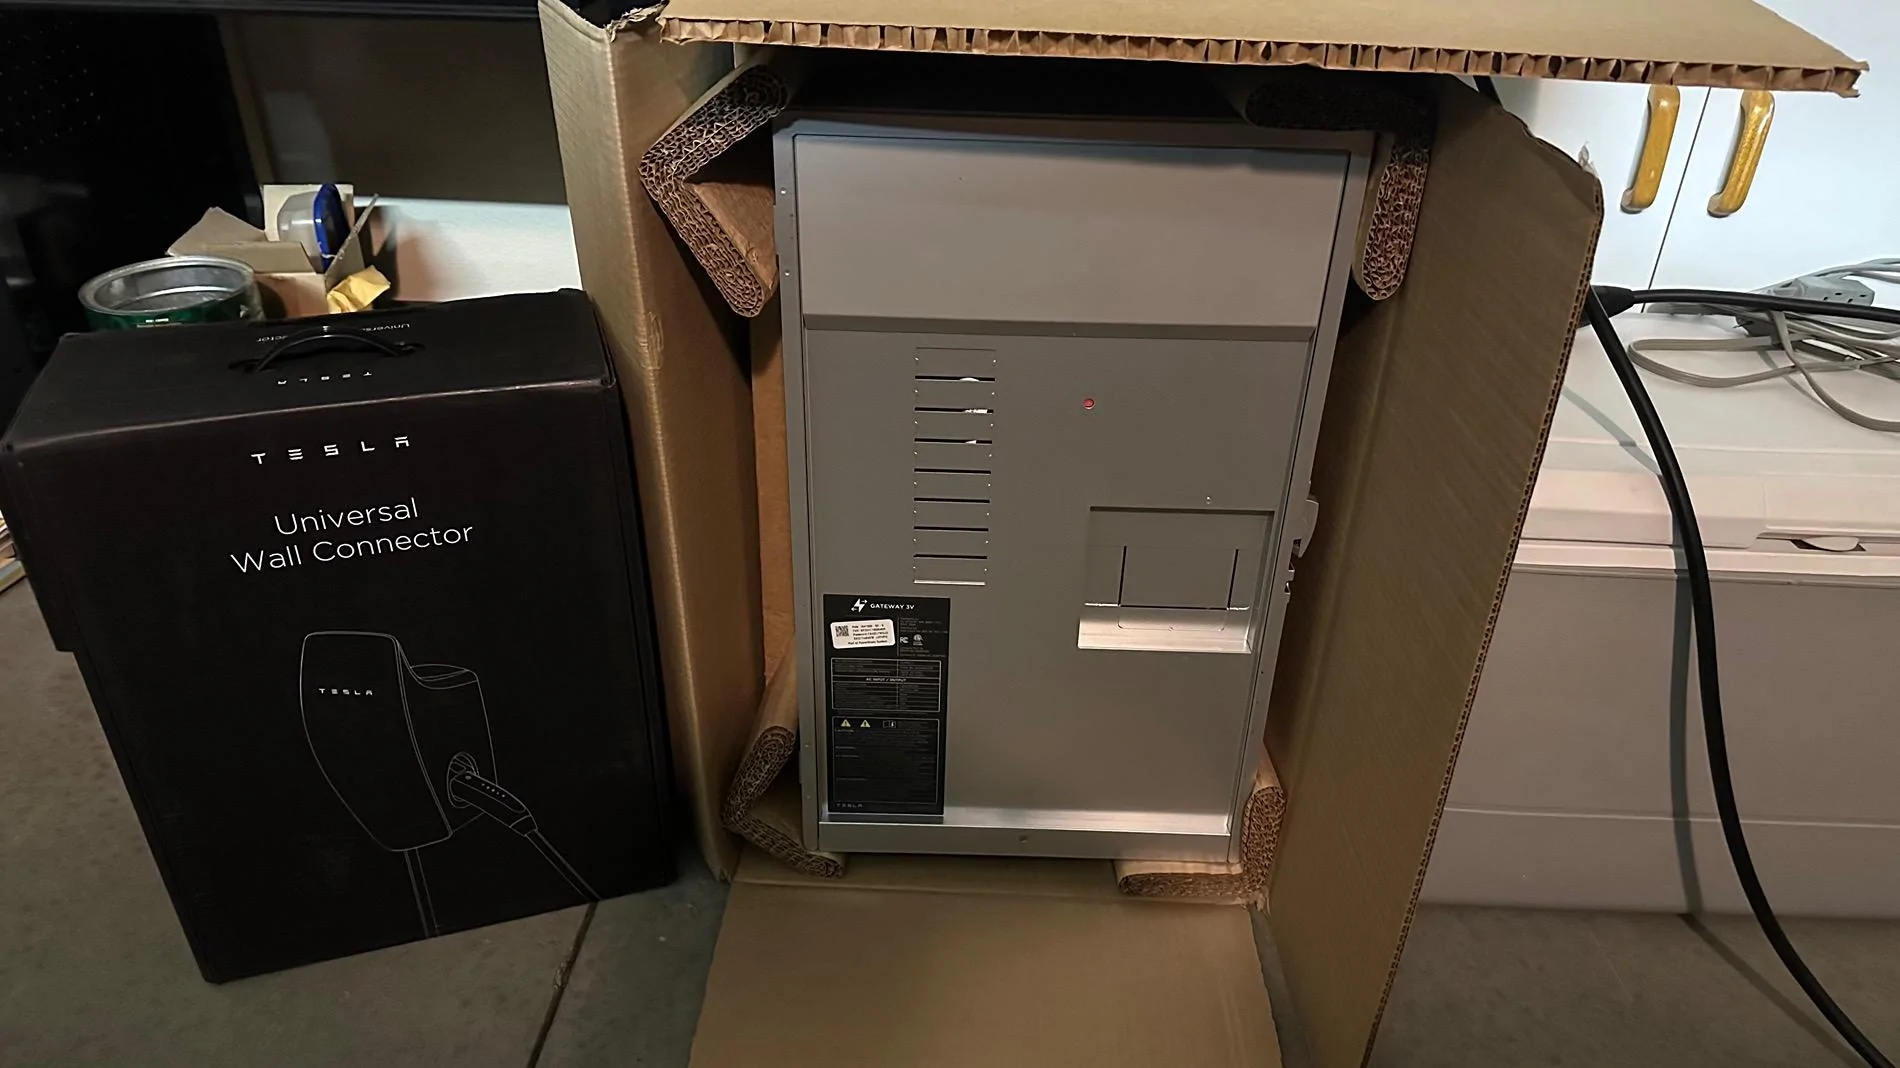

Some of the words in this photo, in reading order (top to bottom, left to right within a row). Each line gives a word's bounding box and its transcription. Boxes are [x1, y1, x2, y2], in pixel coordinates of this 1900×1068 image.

[250, 435, 411, 465] TESLA
[273, 496, 419, 536] Universal
[230, 544, 303, 573] Wall
[312, 525, 474, 562] Connector
[318, 687, 374, 696] TESLA
